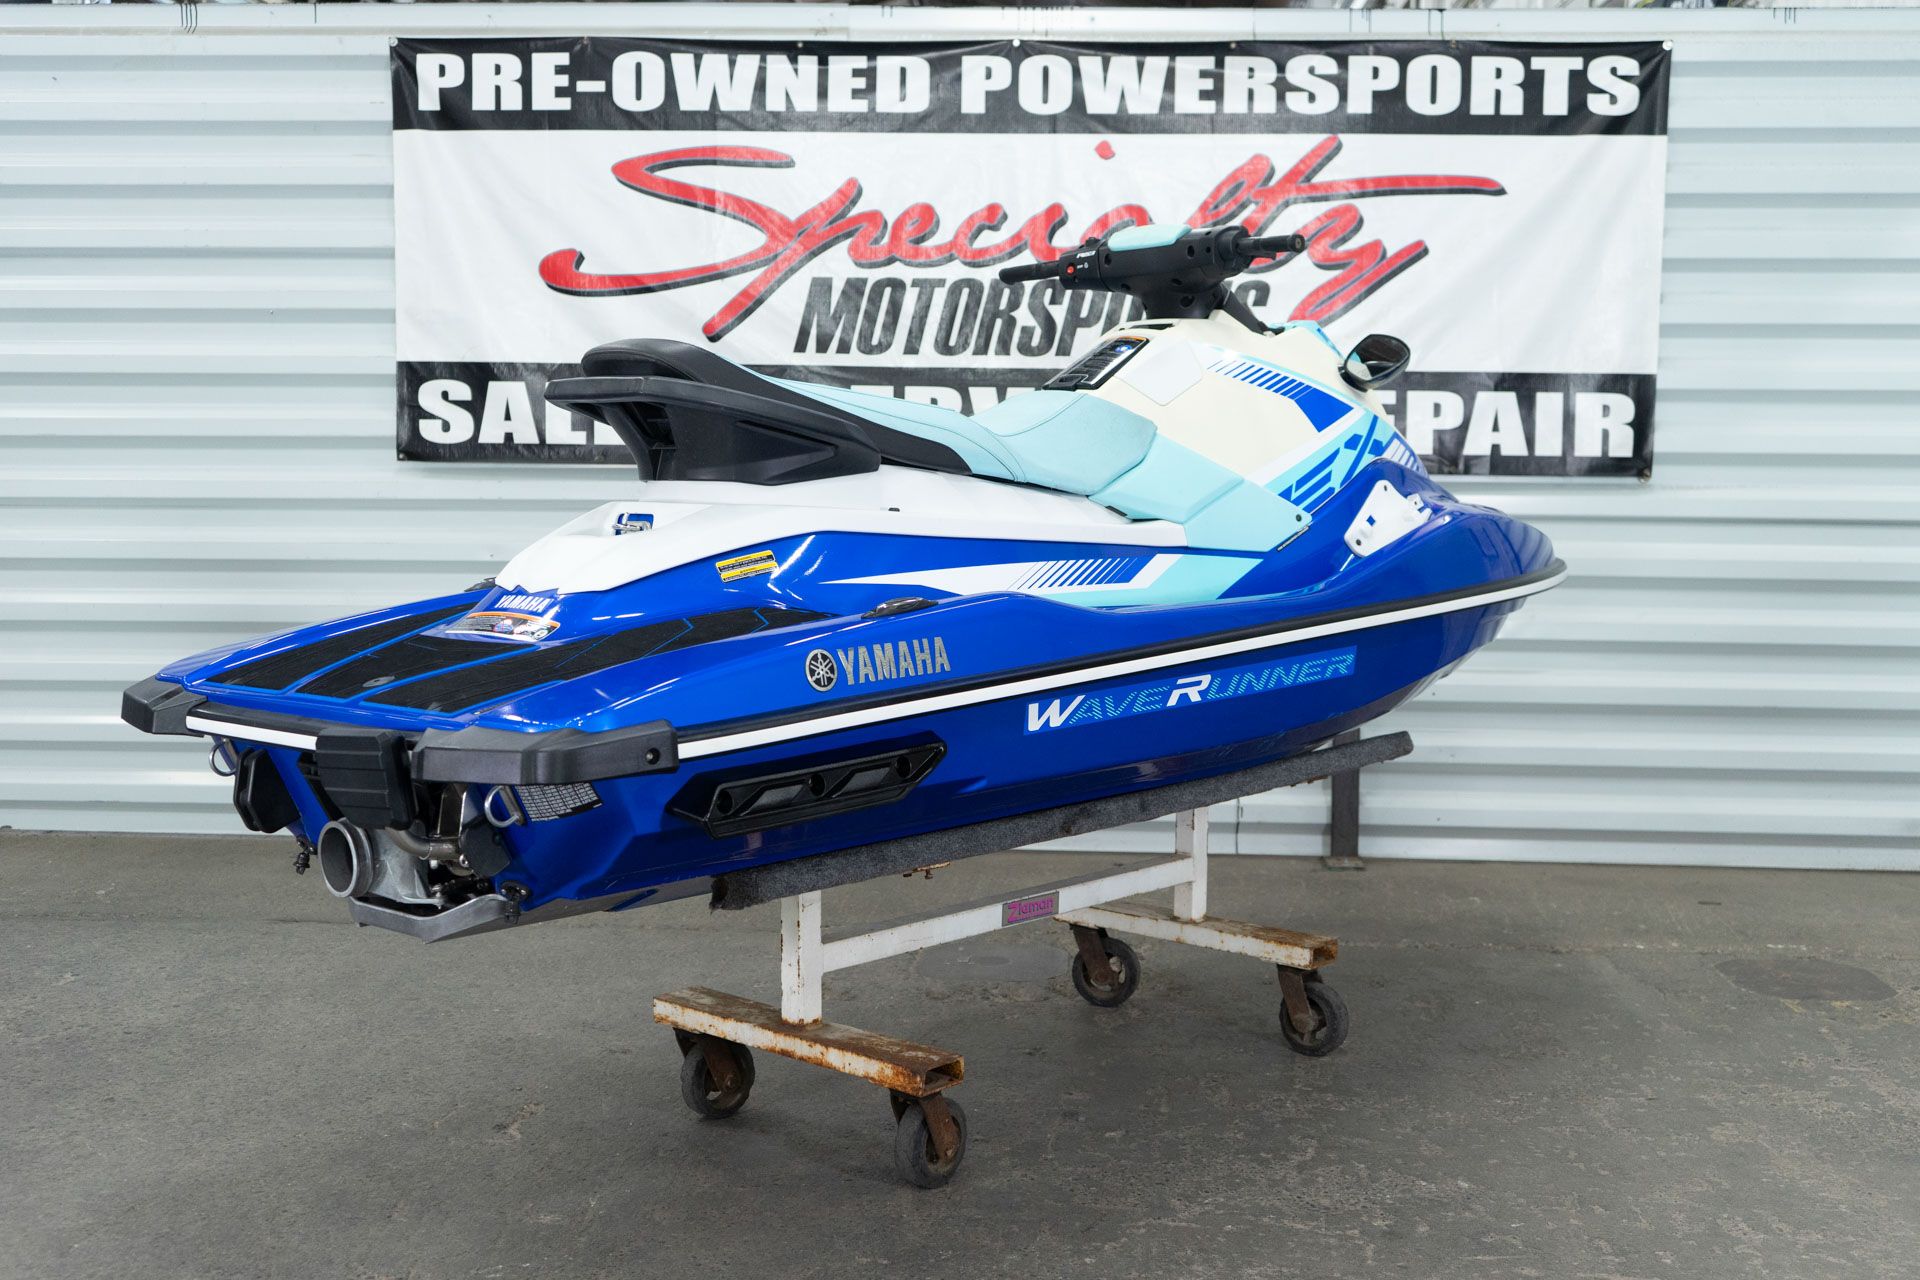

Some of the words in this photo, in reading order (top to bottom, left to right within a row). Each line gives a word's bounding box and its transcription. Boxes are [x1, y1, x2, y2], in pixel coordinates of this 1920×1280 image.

[416, 51, 931, 115] PRE-OWNED
[961, 54, 1641, 117] POWERSPORTS
[794, 276, 1271, 358] MOTORSPS
[417, 378, 627, 446] SAL
[1374, 389, 1636, 458] PAIR
[493, 594, 555, 613] YAMAHA
[836, 635, 951, 686] YAMAHA
